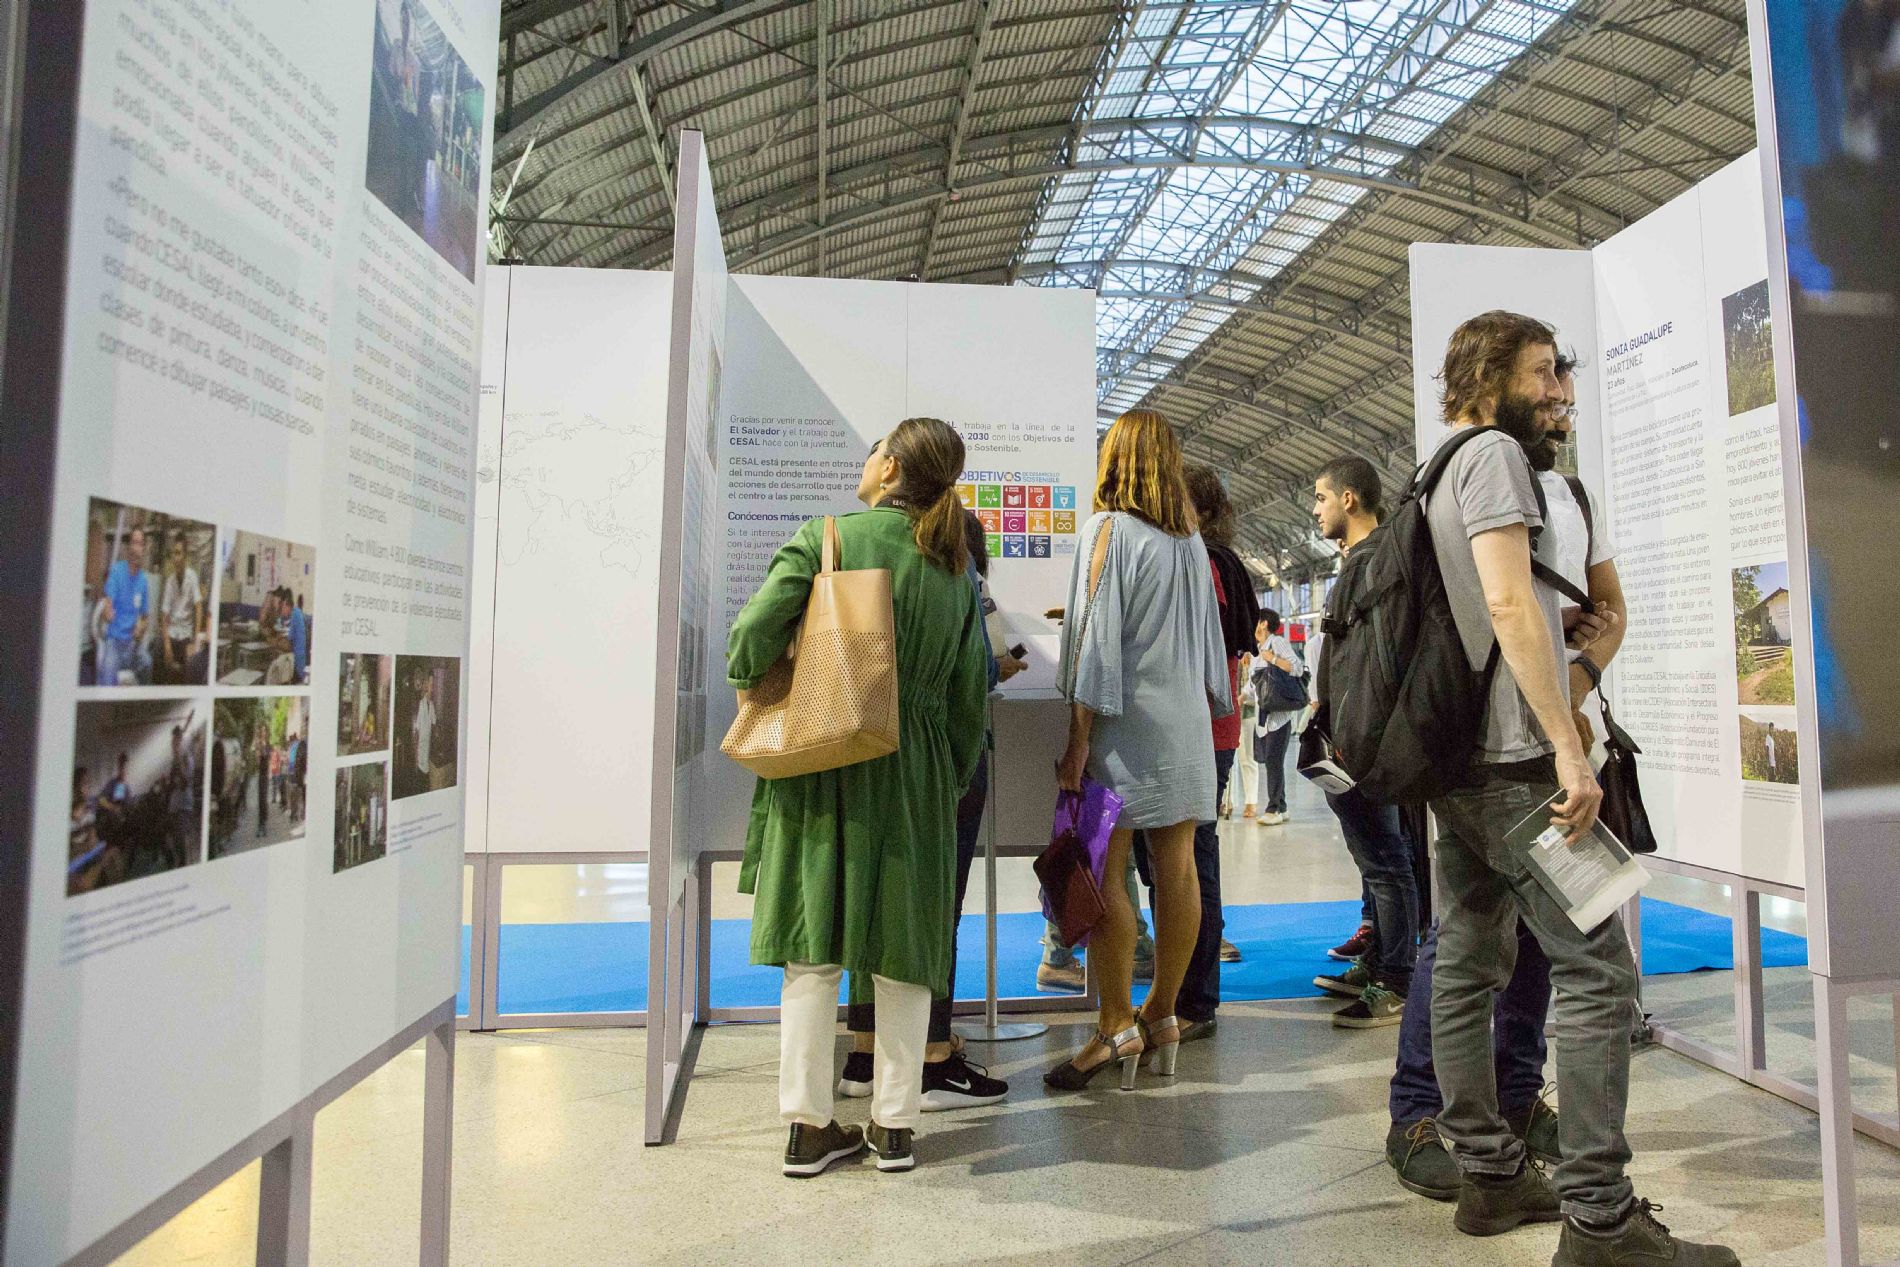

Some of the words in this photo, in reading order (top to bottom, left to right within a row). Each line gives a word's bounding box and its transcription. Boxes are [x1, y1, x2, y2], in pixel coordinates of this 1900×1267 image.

[1606, 342, 1628, 361] SONIA
[1629, 321, 1673, 350] GUADALUPE
[1607, 352, 1643, 376] MARTÍNEZ
[1608, 381, 1614, 390] 23
[1614, 377, 1626, 388] años
[730, 415, 760, 424] Gracias
[762, 417, 775, 426] por
[804, 418, 835, 426] conocer
[964, 421, 992, 431] trabaja
[1012, 423, 1020, 431] la
[1026, 422, 1045, 431] línea
[1067, 424, 1075, 432] la
[730, 426, 739, 434] El
[741, 426, 780, 435] Salvador
[782, 429, 787, 437] y
[789, 427, 797, 436] el
[799, 428, 828, 438] trabajo
[830, 431, 845, 439] que
[968, 432, 989, 441] 2030
[1008, 434, 1020, 442] los
[1023, 434, 1062, 443] Objetivos
[1065, 435, 1075, 443] de
[729, 437, 760, 446] CESAL
[762, 439, 782, 447] hace
[800, 439, 809, 448] la
[810, 440, 848, 449] juventud.
[974, 444, 1021, 453] Sostenible.
[729, 457, 759, 466] CESAL
[761, 457, 778, 466] está
[780, 459, 818, 469] presente
[819, 460, 830, 468] en
[832, 459, 854, 468] otros
[855, 461, 865, 470] pa
[729, 468, 742, 477] del
[744, 468, 774, 478] mundo
[776, 469, 802, 478] donde
[804, 470, 839, 479] también
[840, 472, 863, 481] prom
[959, 471, 1021, 482] OBJETIVOS
[728, 480, 766, 489] acciones
[768, 481, 779, 489] de
[780, 481, 824, 490] desarrollo
[826, 483, 842, 492] que
[844, 483, 860, 492] pon
[728, 492, 736, 500] el
[738, 492, 766, 501] centro
[775, 493, 787, 501] las
[790, 494, 832, 503] personas.
[728, 511, 778, 521] Conócenos
[780, 512, 800, 521] más
[728, 528, 736, 537] Si
[740, 529, 748, 537] te
[751, 529, 785, 537] interesa
[727, 540, 742, 548] con
[744, 540, 752, 548] la
[1767, 532, 1785, 545] propo
[727, 551, 769, 561] regístrate
[726, 562, 745, 571] drás
[747, 563, 755, 571] la
[726, 575, 767, 583] realidade
[726, 585, 748, 595] Haití,
